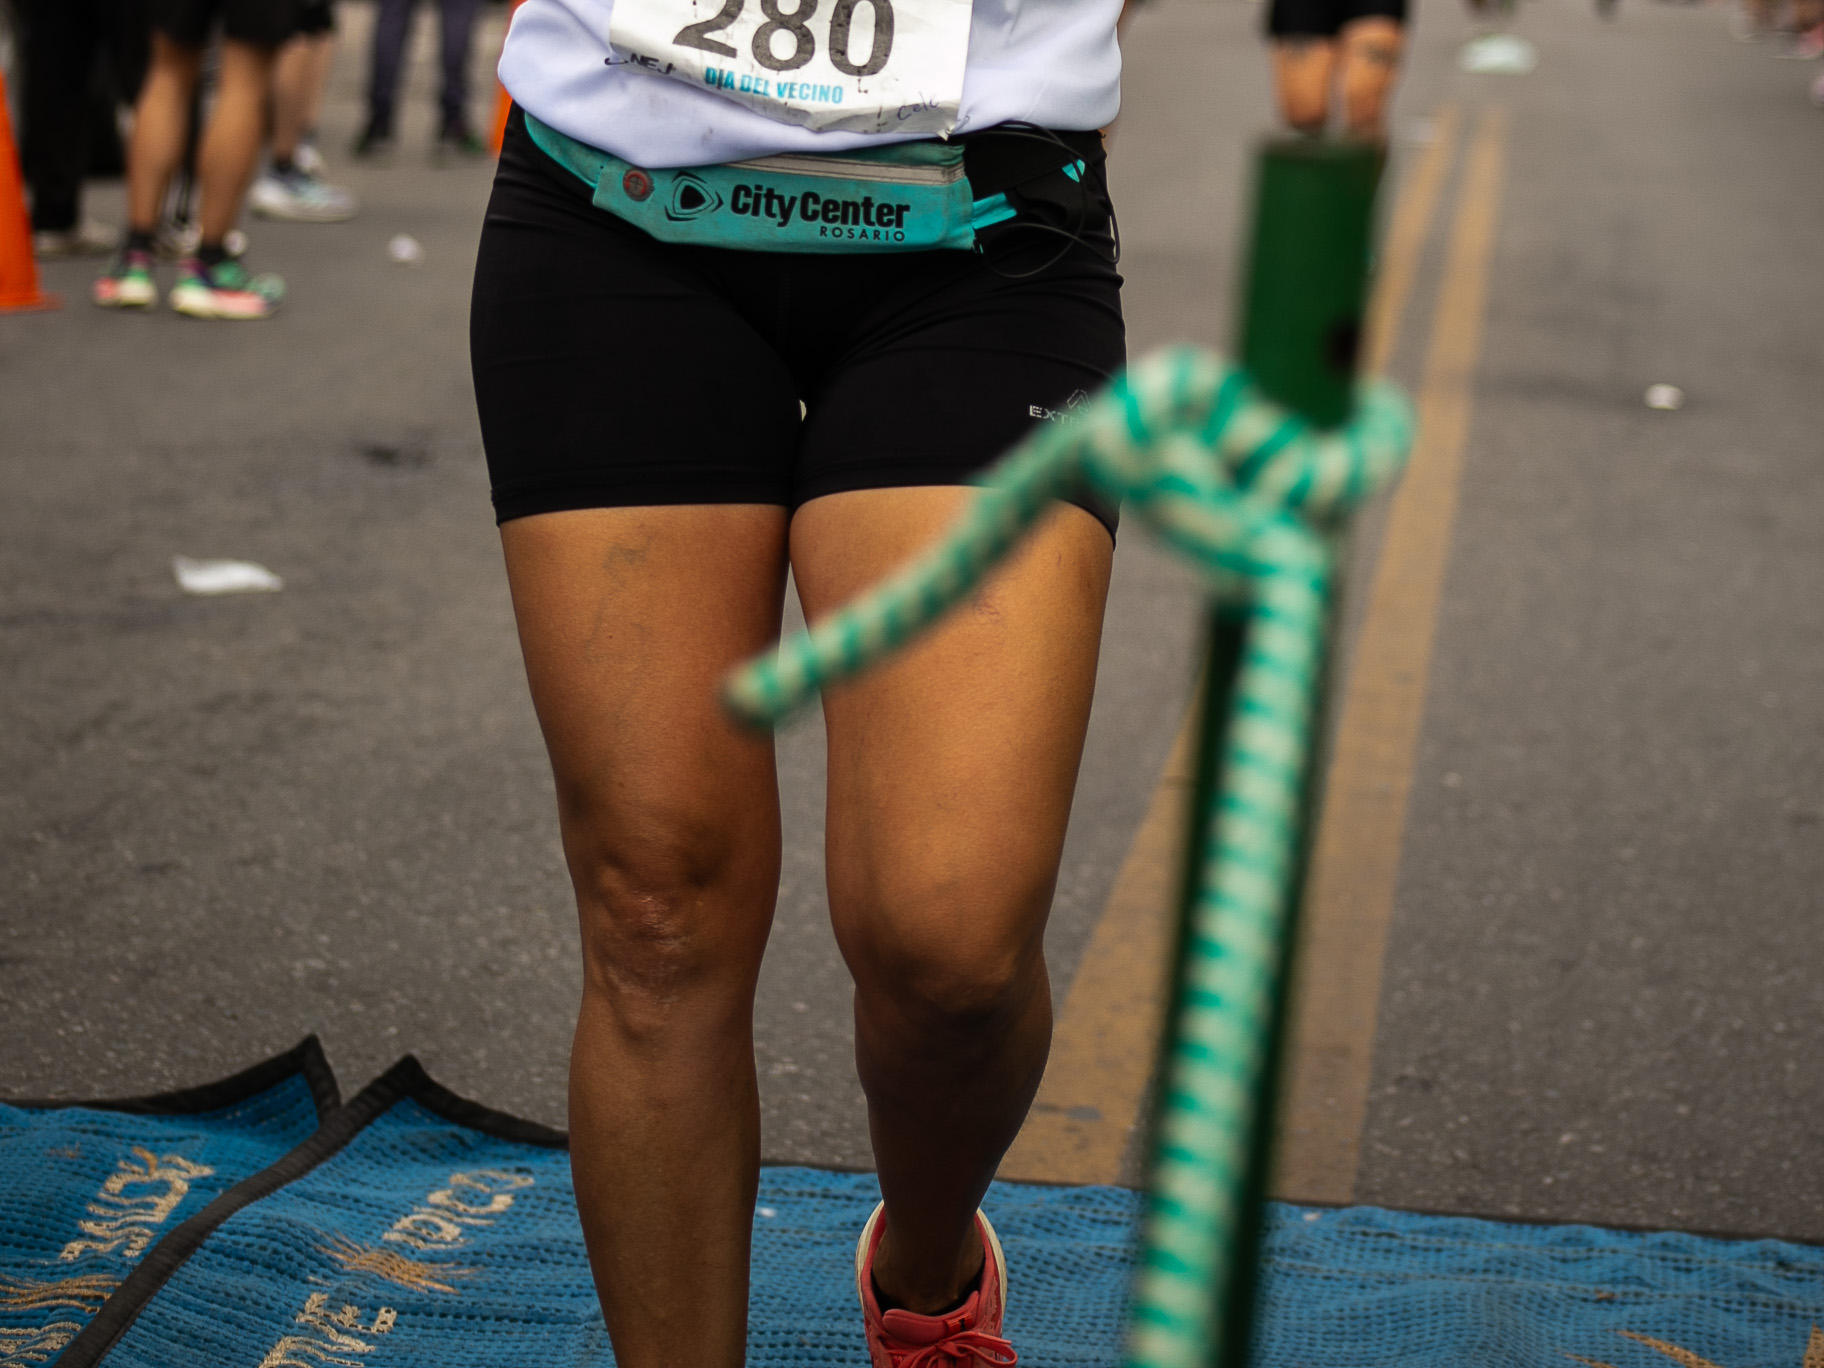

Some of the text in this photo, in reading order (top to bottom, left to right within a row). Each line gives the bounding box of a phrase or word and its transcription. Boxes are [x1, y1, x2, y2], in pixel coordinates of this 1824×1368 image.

[739, 74, 771, 98] DEL
[776, 81, 844, 104] VECINO
[819, 226, 905, 242] ROSARIO
